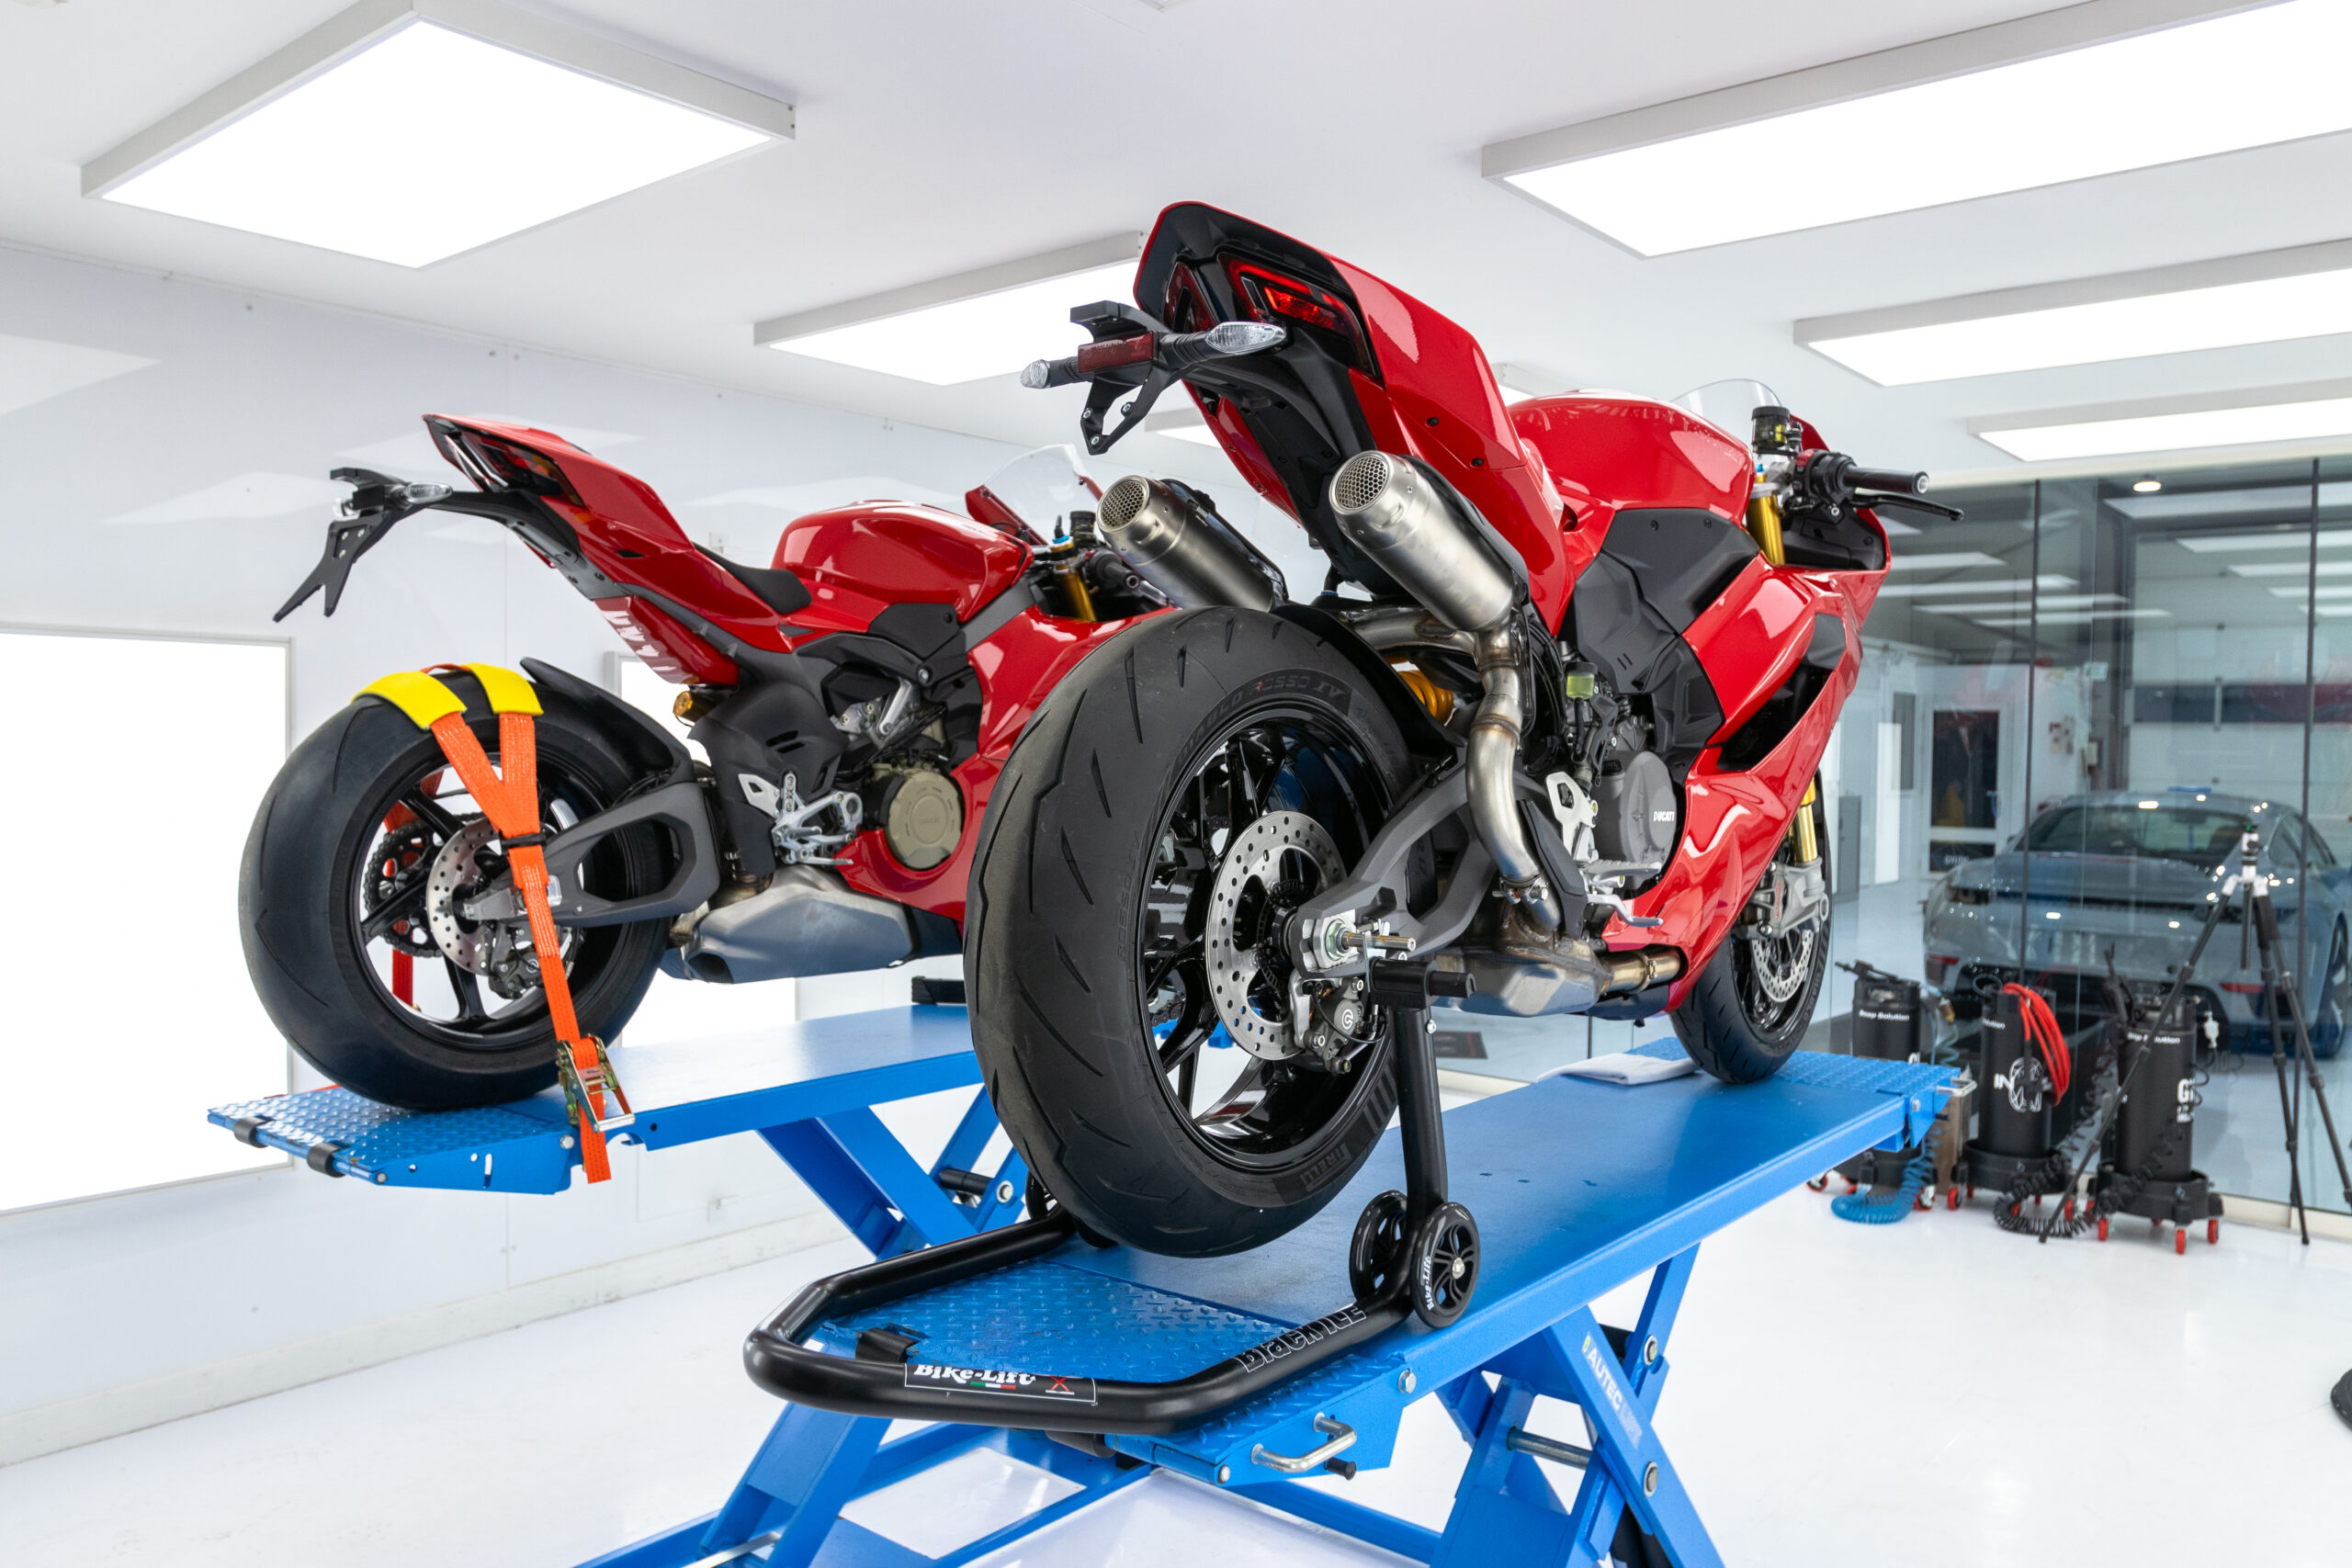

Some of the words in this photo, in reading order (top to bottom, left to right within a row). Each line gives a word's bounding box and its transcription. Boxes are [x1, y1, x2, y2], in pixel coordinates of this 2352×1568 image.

[1654, 811, 1675, 821] DUCATI
[1878, 1011, 1909, 1021] Solution
[1423, 1255, 1435, 1311] Bike-Lift
[913, 1364, 1036, 1385] Bike-Lift
[1587, 1348, 1623, 1411] AUTEC
